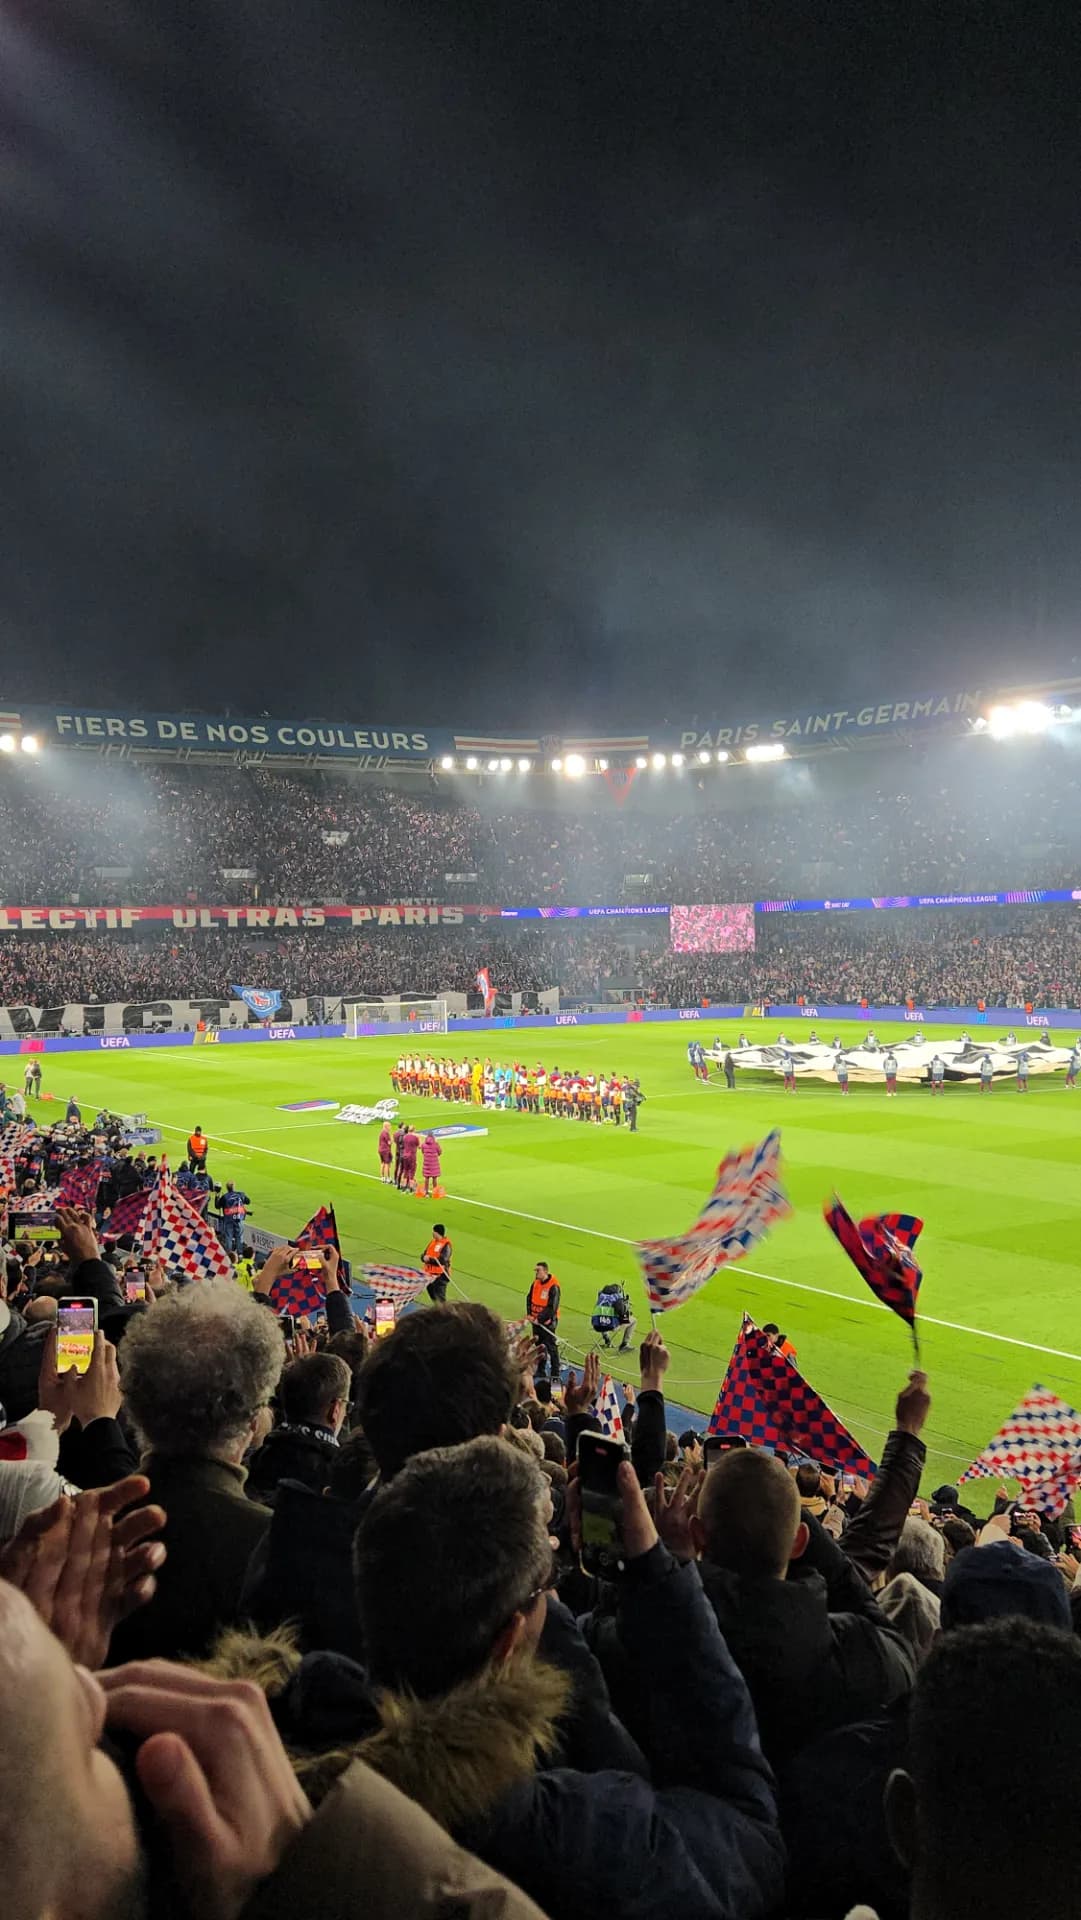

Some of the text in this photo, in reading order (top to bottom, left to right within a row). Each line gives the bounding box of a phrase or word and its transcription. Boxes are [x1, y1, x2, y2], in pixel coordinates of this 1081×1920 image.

[680, 690, 983, 749] PARIS SAINT-GERMAIN
[55, 714, 430, 752] FIERS DE NOS COULEURS
[935, 896, 973, 904] CHAMPIONS
[973, 895, 998, 903] LEAGUE
[588, 906, 669, 916] UEFA CHAMPIONS LEAGUE
[172, 907, 327, 929] ULTRAS
[351, 906, 465, 927] PARIS
[679, 1008, 700, 1019] UEFA
[801, 1007, 818, 1017] UEFA
[904, 1011, 925, 1021] UEFA
[555, 1015, 578, 1025] UEFA
[1025, 1015, 1049, 1026] UEFA
[204, 1031, 220, 1043] ALL
[268, 1028, 296, 1040] UEFA
[101, 1036, 130, 1048] UEFA
